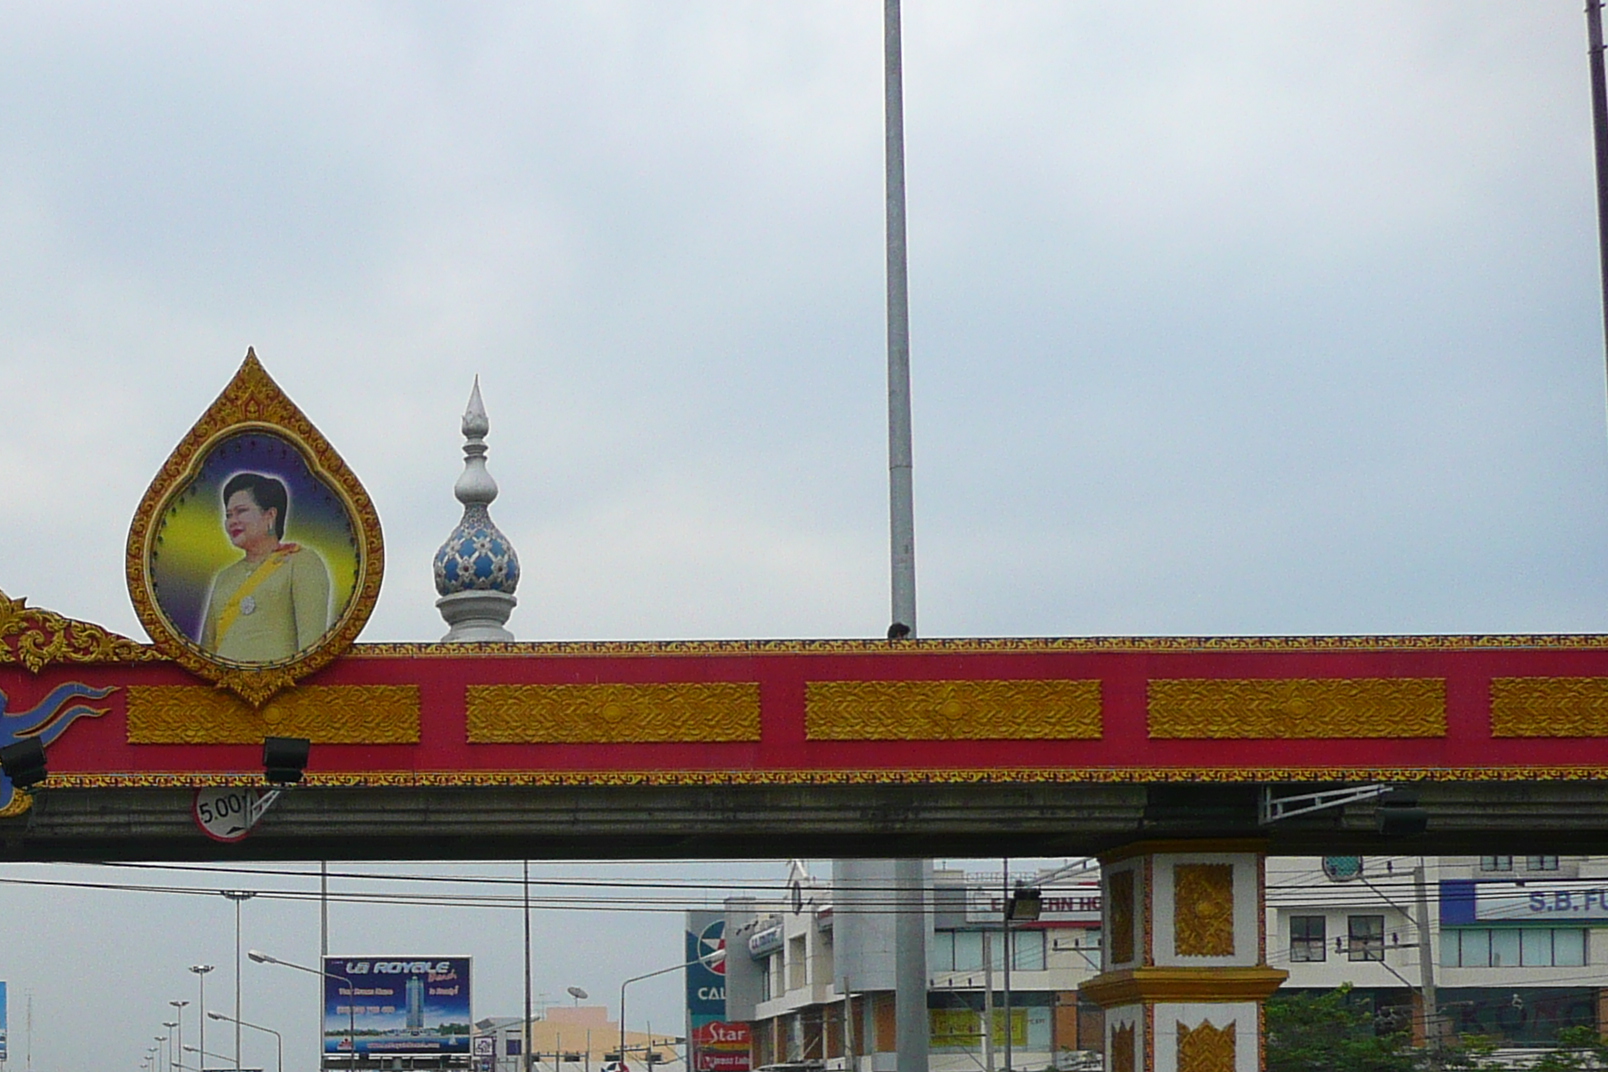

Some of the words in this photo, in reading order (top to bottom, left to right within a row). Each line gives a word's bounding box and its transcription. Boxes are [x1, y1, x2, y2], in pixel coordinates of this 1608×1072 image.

[1080, 897, 1102, 911] HO
[1584, 890, 1608, 911] FU
[698, 987, 727, 1000] CAL
[709, 1023, 746, 1044] Star
